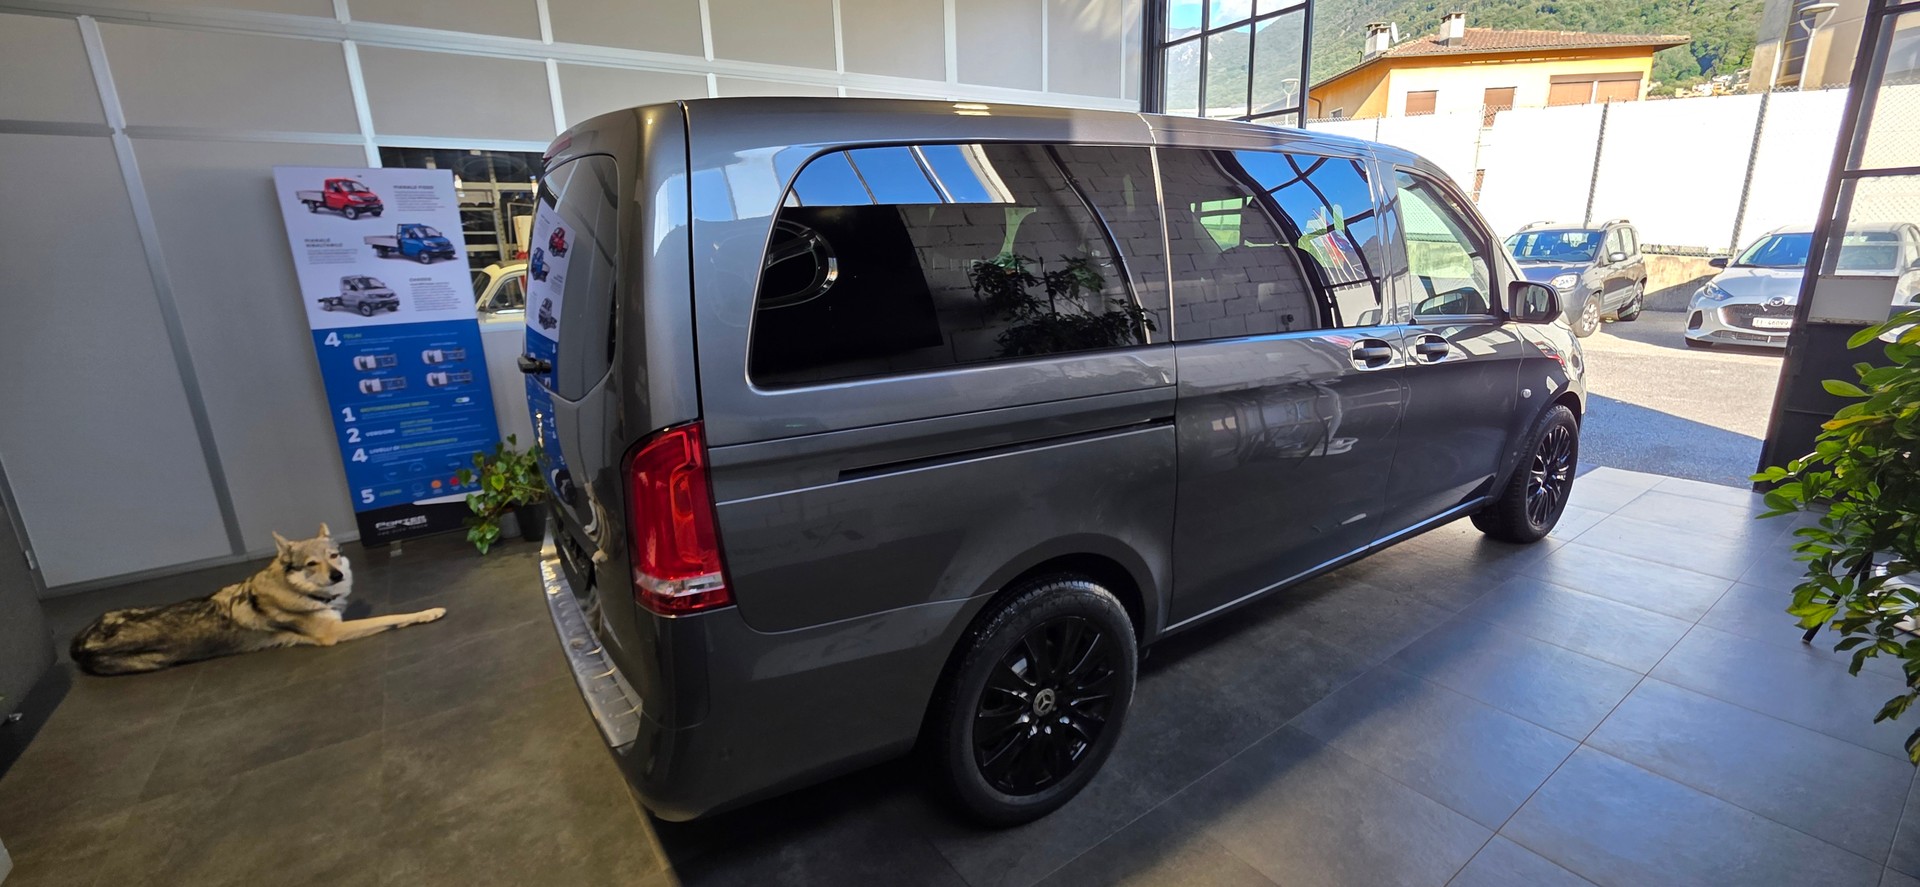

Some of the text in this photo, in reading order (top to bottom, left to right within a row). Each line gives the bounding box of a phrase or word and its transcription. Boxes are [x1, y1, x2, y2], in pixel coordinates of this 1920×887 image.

[324, 332, 341, 347] 4
[342, 407, 356, 422] 1
[346, 427, 361, 443] 2
[352, 448, 368, 462] 4
[361, 489, 375, 504] 5
